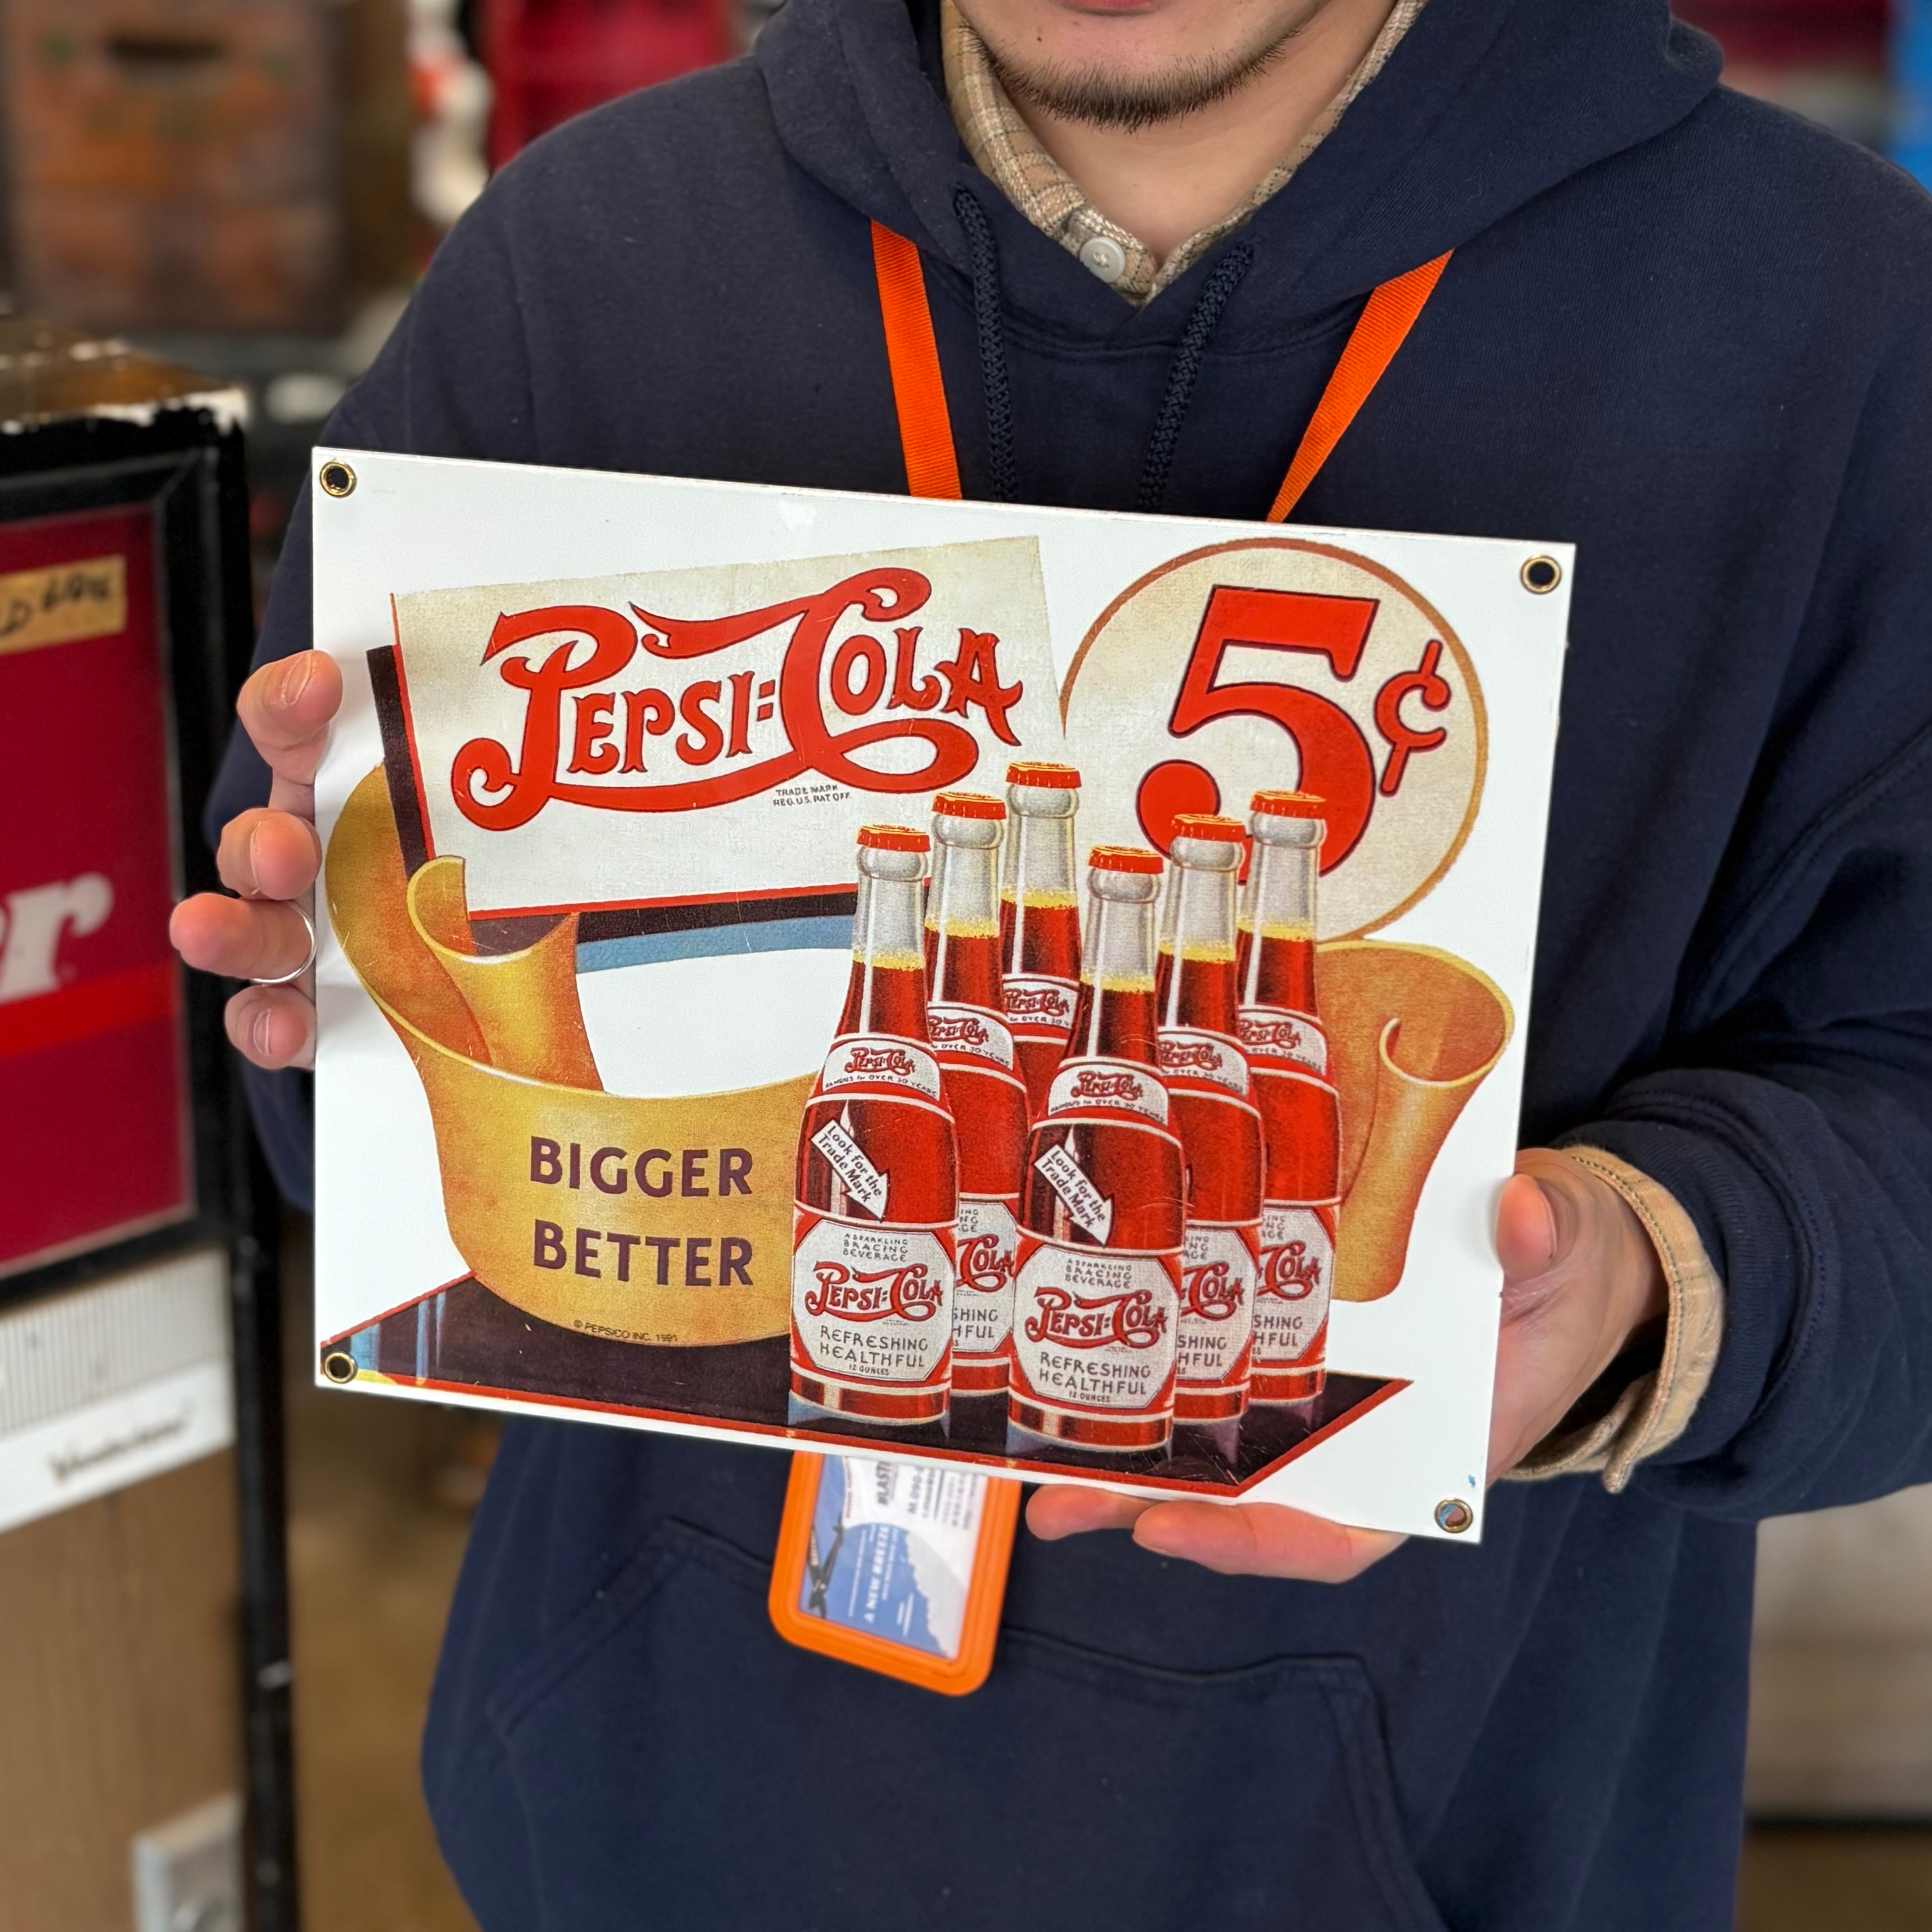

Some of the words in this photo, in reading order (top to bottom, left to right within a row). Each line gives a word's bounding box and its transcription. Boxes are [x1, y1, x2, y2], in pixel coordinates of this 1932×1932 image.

[776, 787, 808, 796] TRADE
[810, 784, 838, 793] MARK
[530, 1136, 753, 1197] BIGGER
[818, 1133, 848, 1170] Trade
[845, 1169, 871, 1202] Mark
[827, 1125, 853, 1156] Look
[851, 1155, 868, 1173] for
[865, 1175, 882, 1196] the
[1042, 1157, 1072, 1195] Trade
[1068, 1193, 1095, 1228] Mark
[1051, 1150, 1076, 1180] Look
[1075, 1179, 1092, 1199] for
[1089, 1200, 1105, 1221] the
[533, 1219, 753, 1286] BETTER
[842, 1248, 907, 1262] BEVERAGE
[843, 1240, 908, 1254] BRACING
[1065, 1265, 1131, 1280] BRACING
[1065, 1273, 1131, 1289] BEVERAGE
[585, 1322, 631, 1339] PEPSICO
[821, 1325, 928, 1351] REFRESHING
[820, 1342, 925, 1368] HEALTHFUL
[1040, 1351, 1151, 1379] REFRESHING
[859, 1365, 890, 1376] OUNCES
[1039, 1368, 1147, 1395] HEALTHFUL
[866, 1576, 881, 1610] NEW
